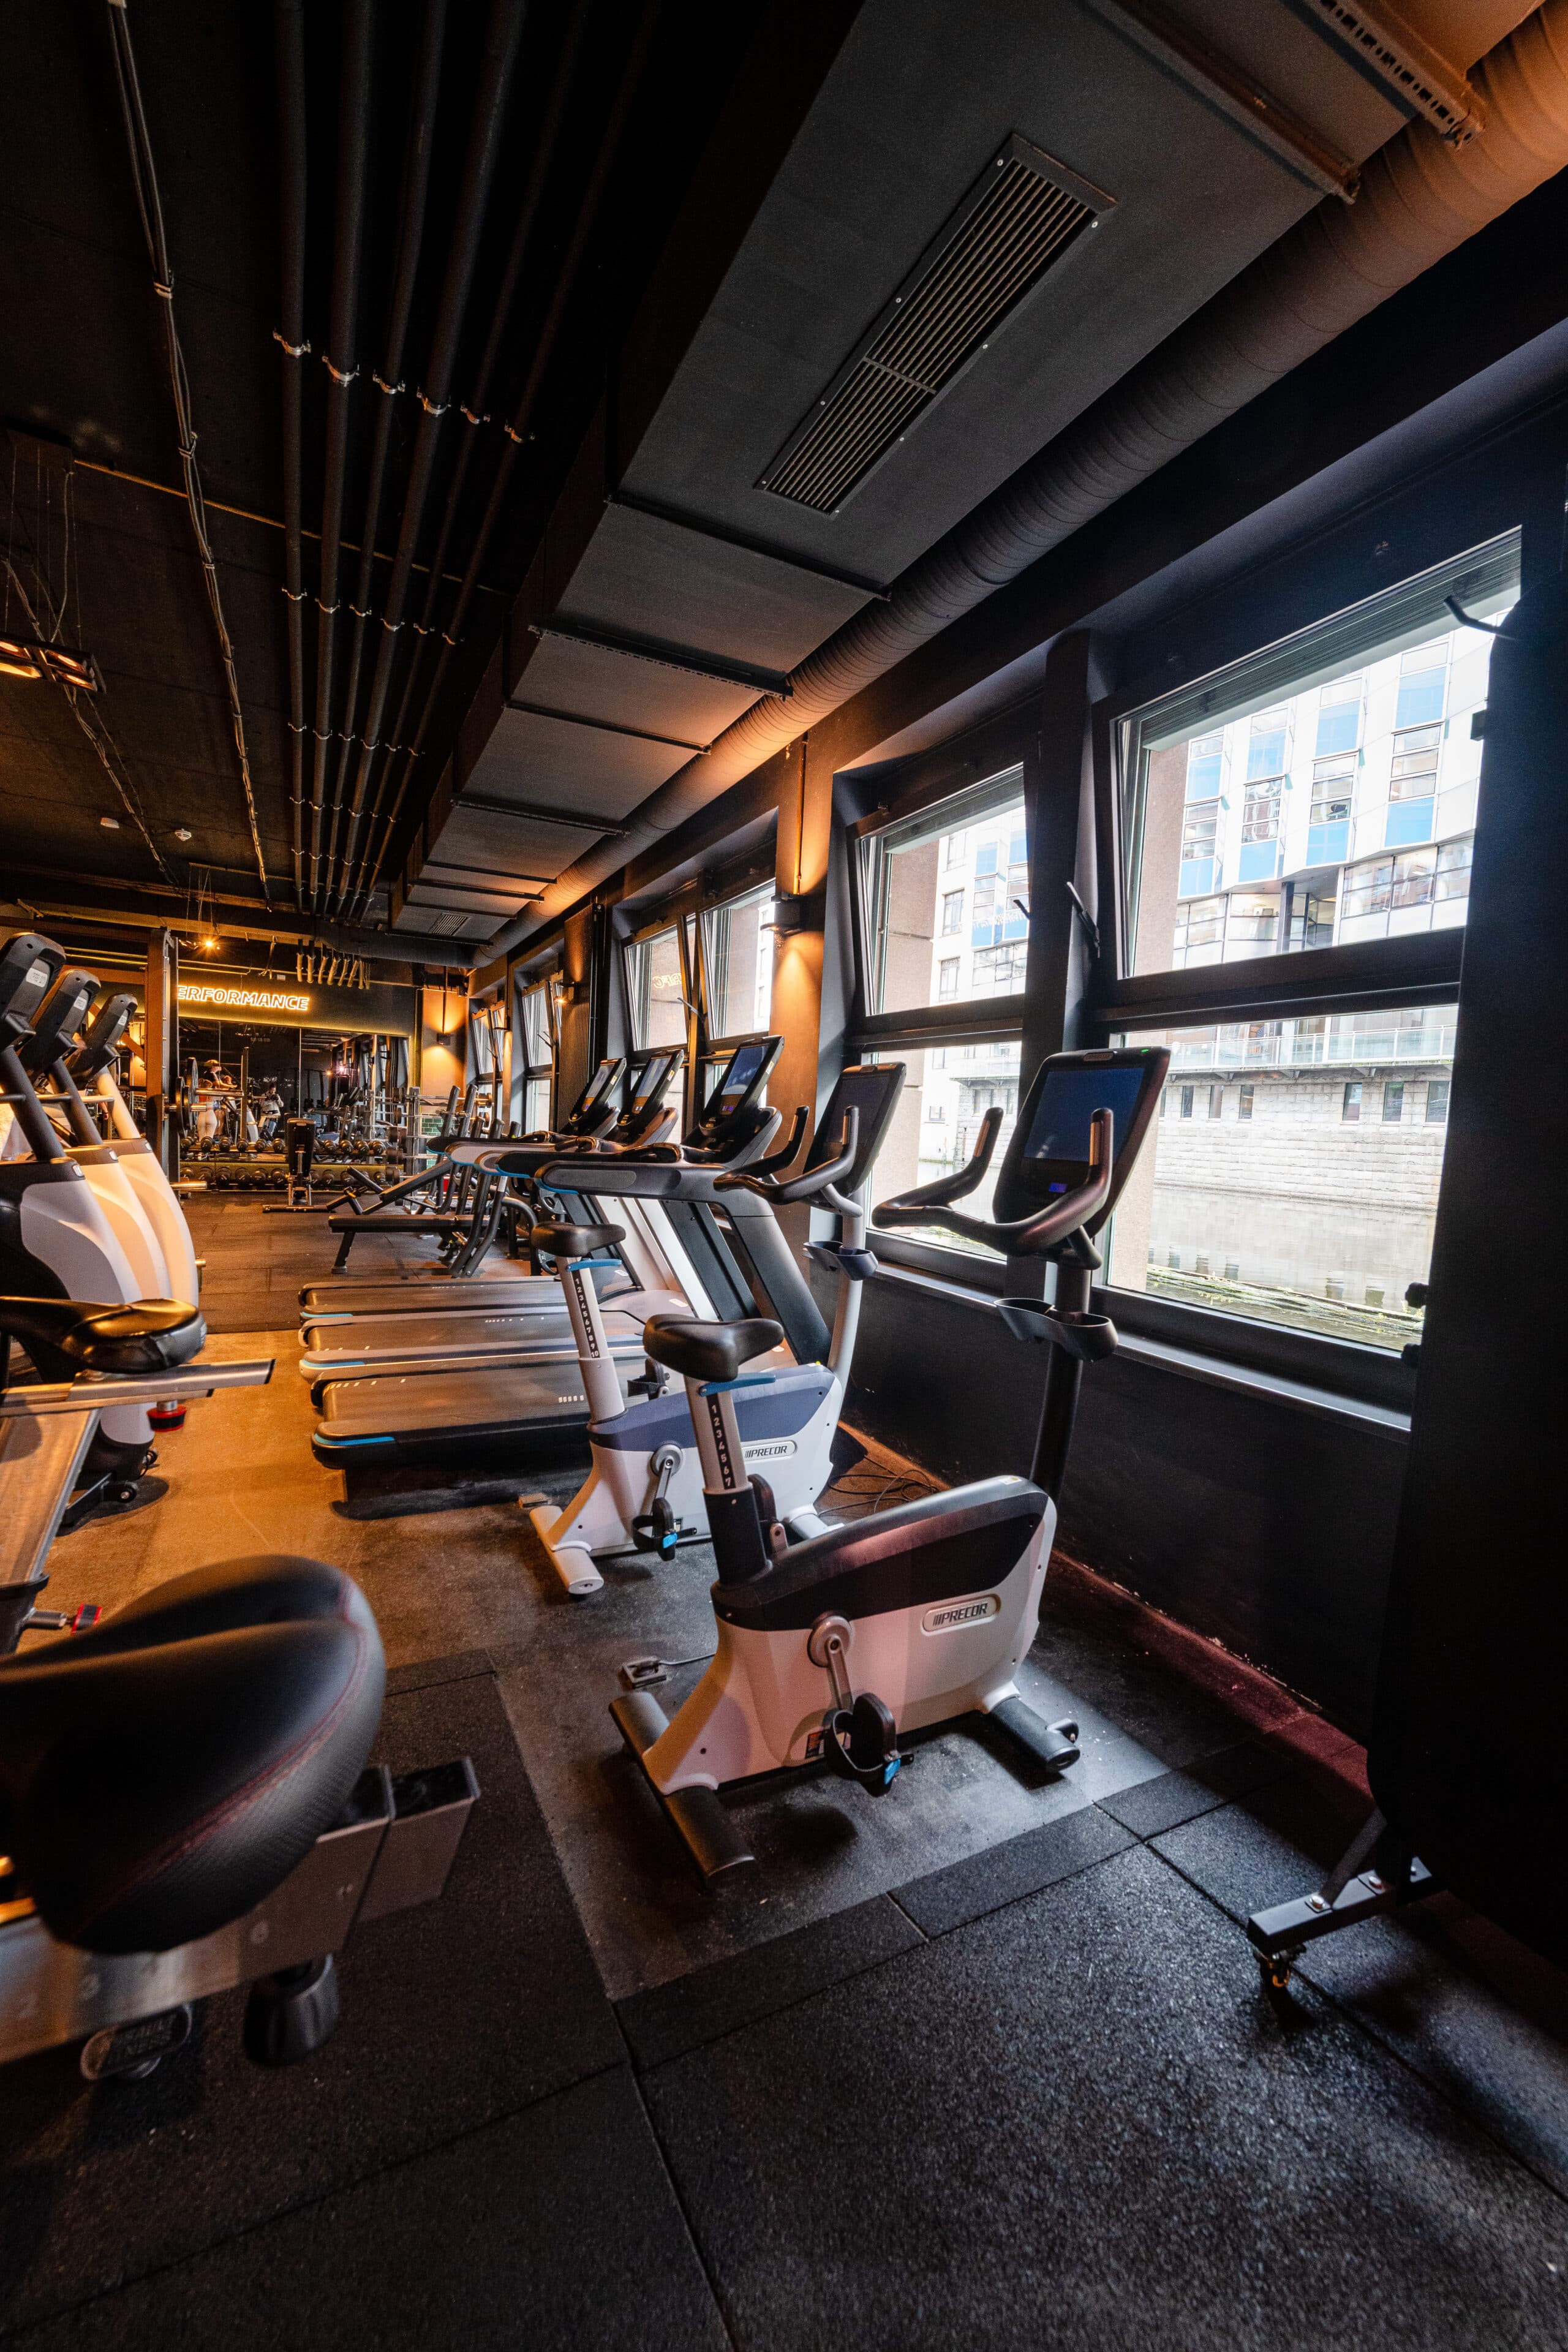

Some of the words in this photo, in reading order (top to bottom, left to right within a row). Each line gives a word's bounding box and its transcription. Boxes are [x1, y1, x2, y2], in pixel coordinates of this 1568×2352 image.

[177, 985, 309, 1011] ERFORMANCE
[714, 1418, 720, 1427] 2
[718, 1442, 725, 1450] 4
[751, 1446, 787, 1457] PRECOR
[721, 1454, 726, 1463] 5
[723, 1466, 729, 1474] 6
[725, 1478, 731, 1487] 7
[940, 1603, 987, 1624] PRECOR
